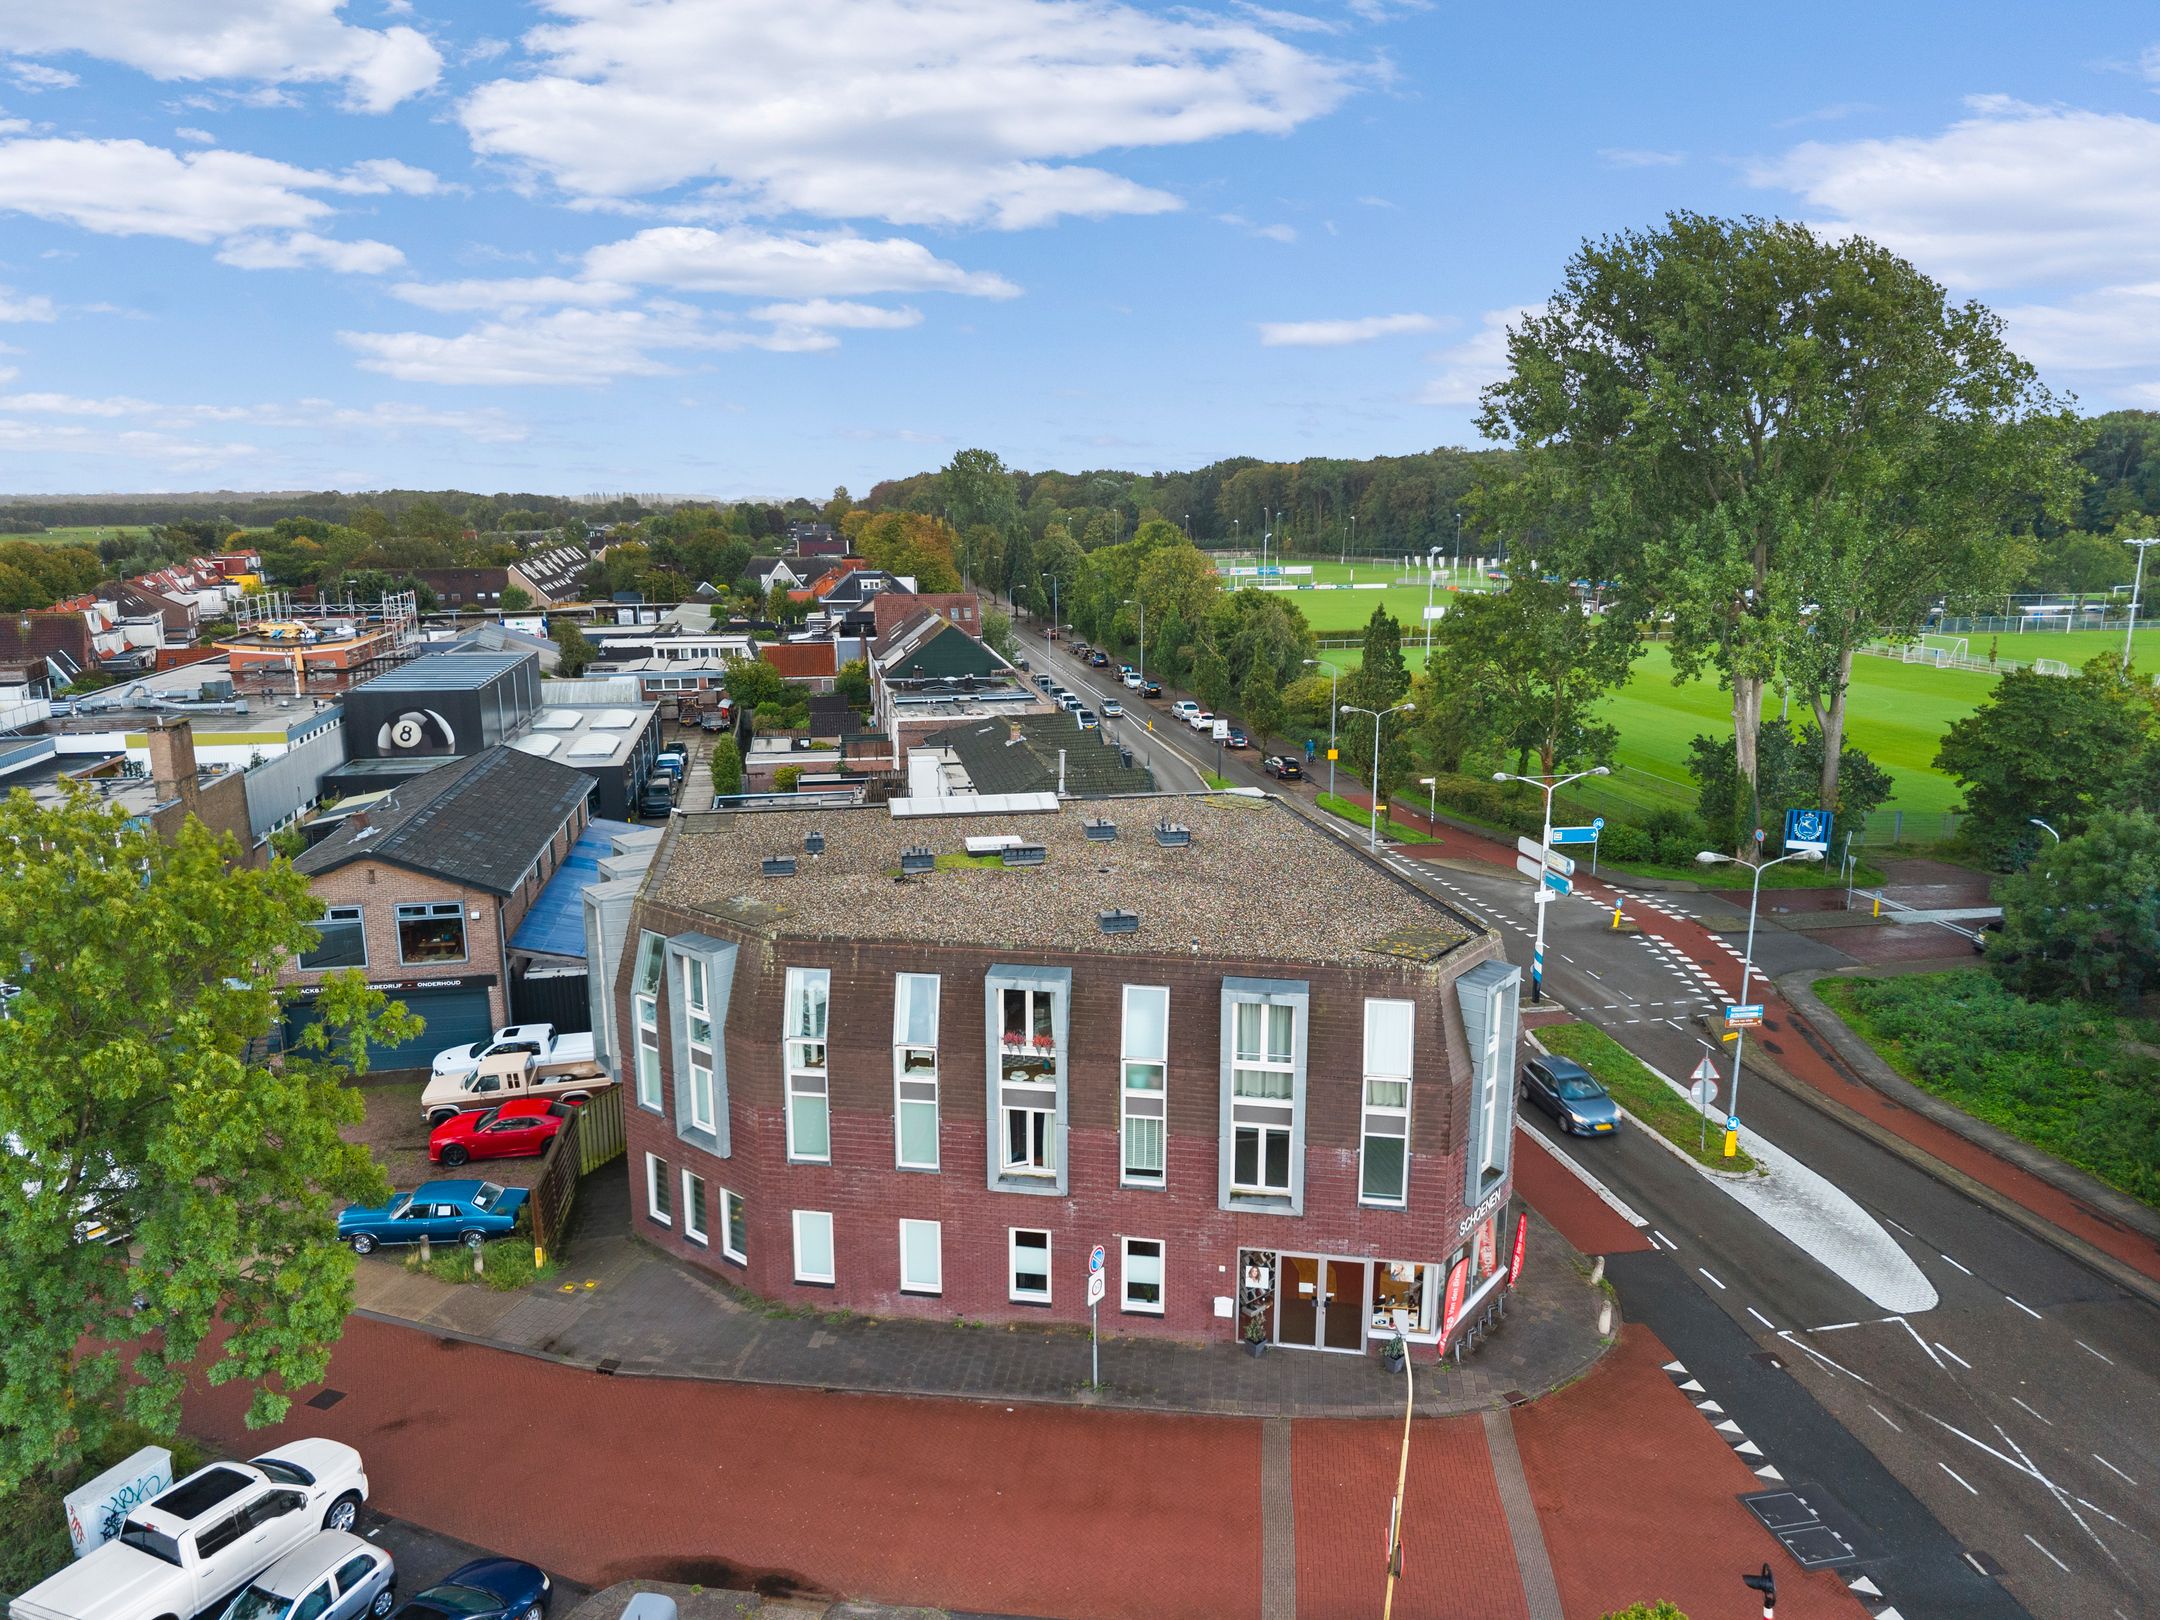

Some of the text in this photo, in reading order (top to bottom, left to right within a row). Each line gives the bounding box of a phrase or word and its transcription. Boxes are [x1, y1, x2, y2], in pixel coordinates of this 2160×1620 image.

[400, 725, 412, 742] 8
[364, 982, 403, 991] GEBEDRIJF
[416, 979, 462, 988] ONDERHOUD
[1459, 1187, 1501, 1236] SCHOENEN
[1451, 1288, 1459, 1302] den
[1448, 1302, 1456, 1315] Van
